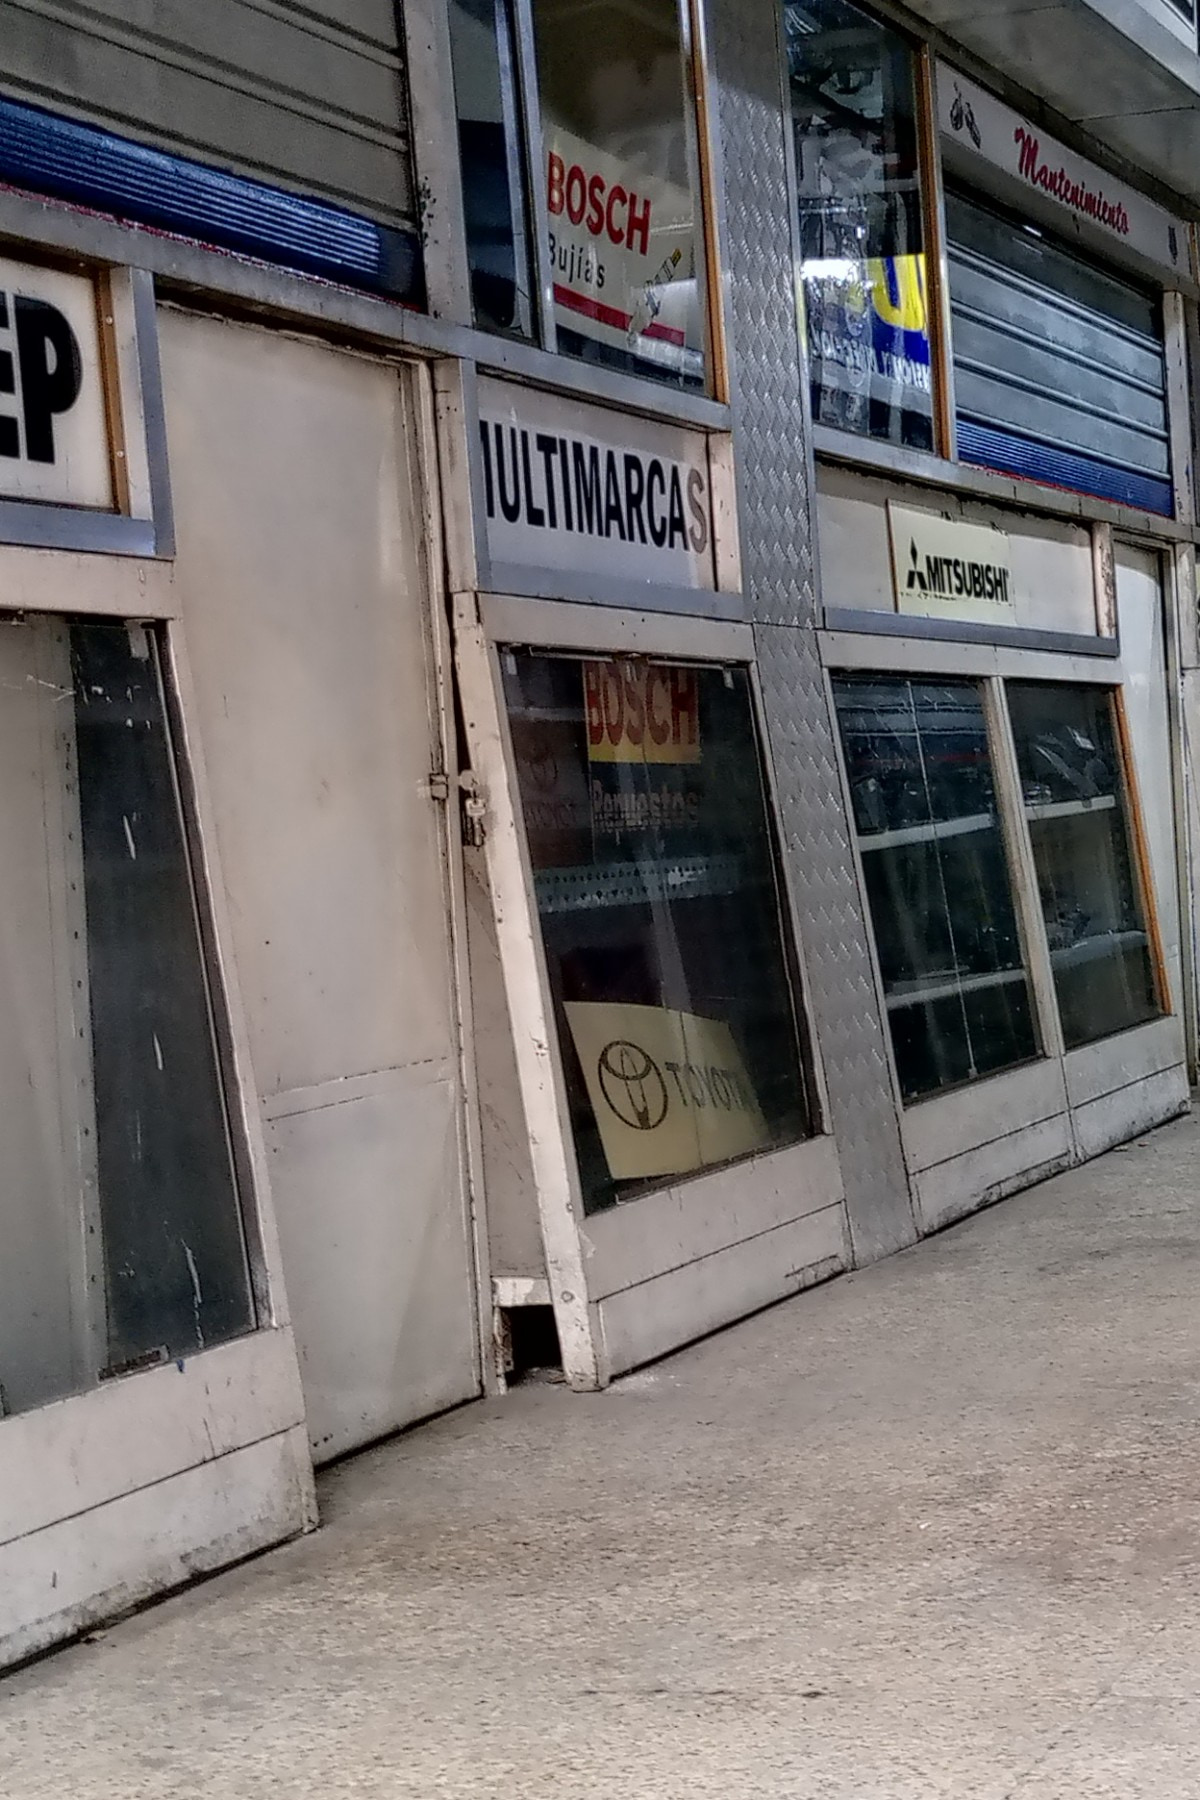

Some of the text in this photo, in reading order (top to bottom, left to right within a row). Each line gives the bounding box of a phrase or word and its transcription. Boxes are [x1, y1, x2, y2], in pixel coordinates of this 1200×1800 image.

[547, 150, 651, 256] BOSCH
[1014, 126, 1130, 236] Mantenimiento
[925, 554, 1009, 602] MITSUBISHI
[584, 660, 698, 746] BOSCH
